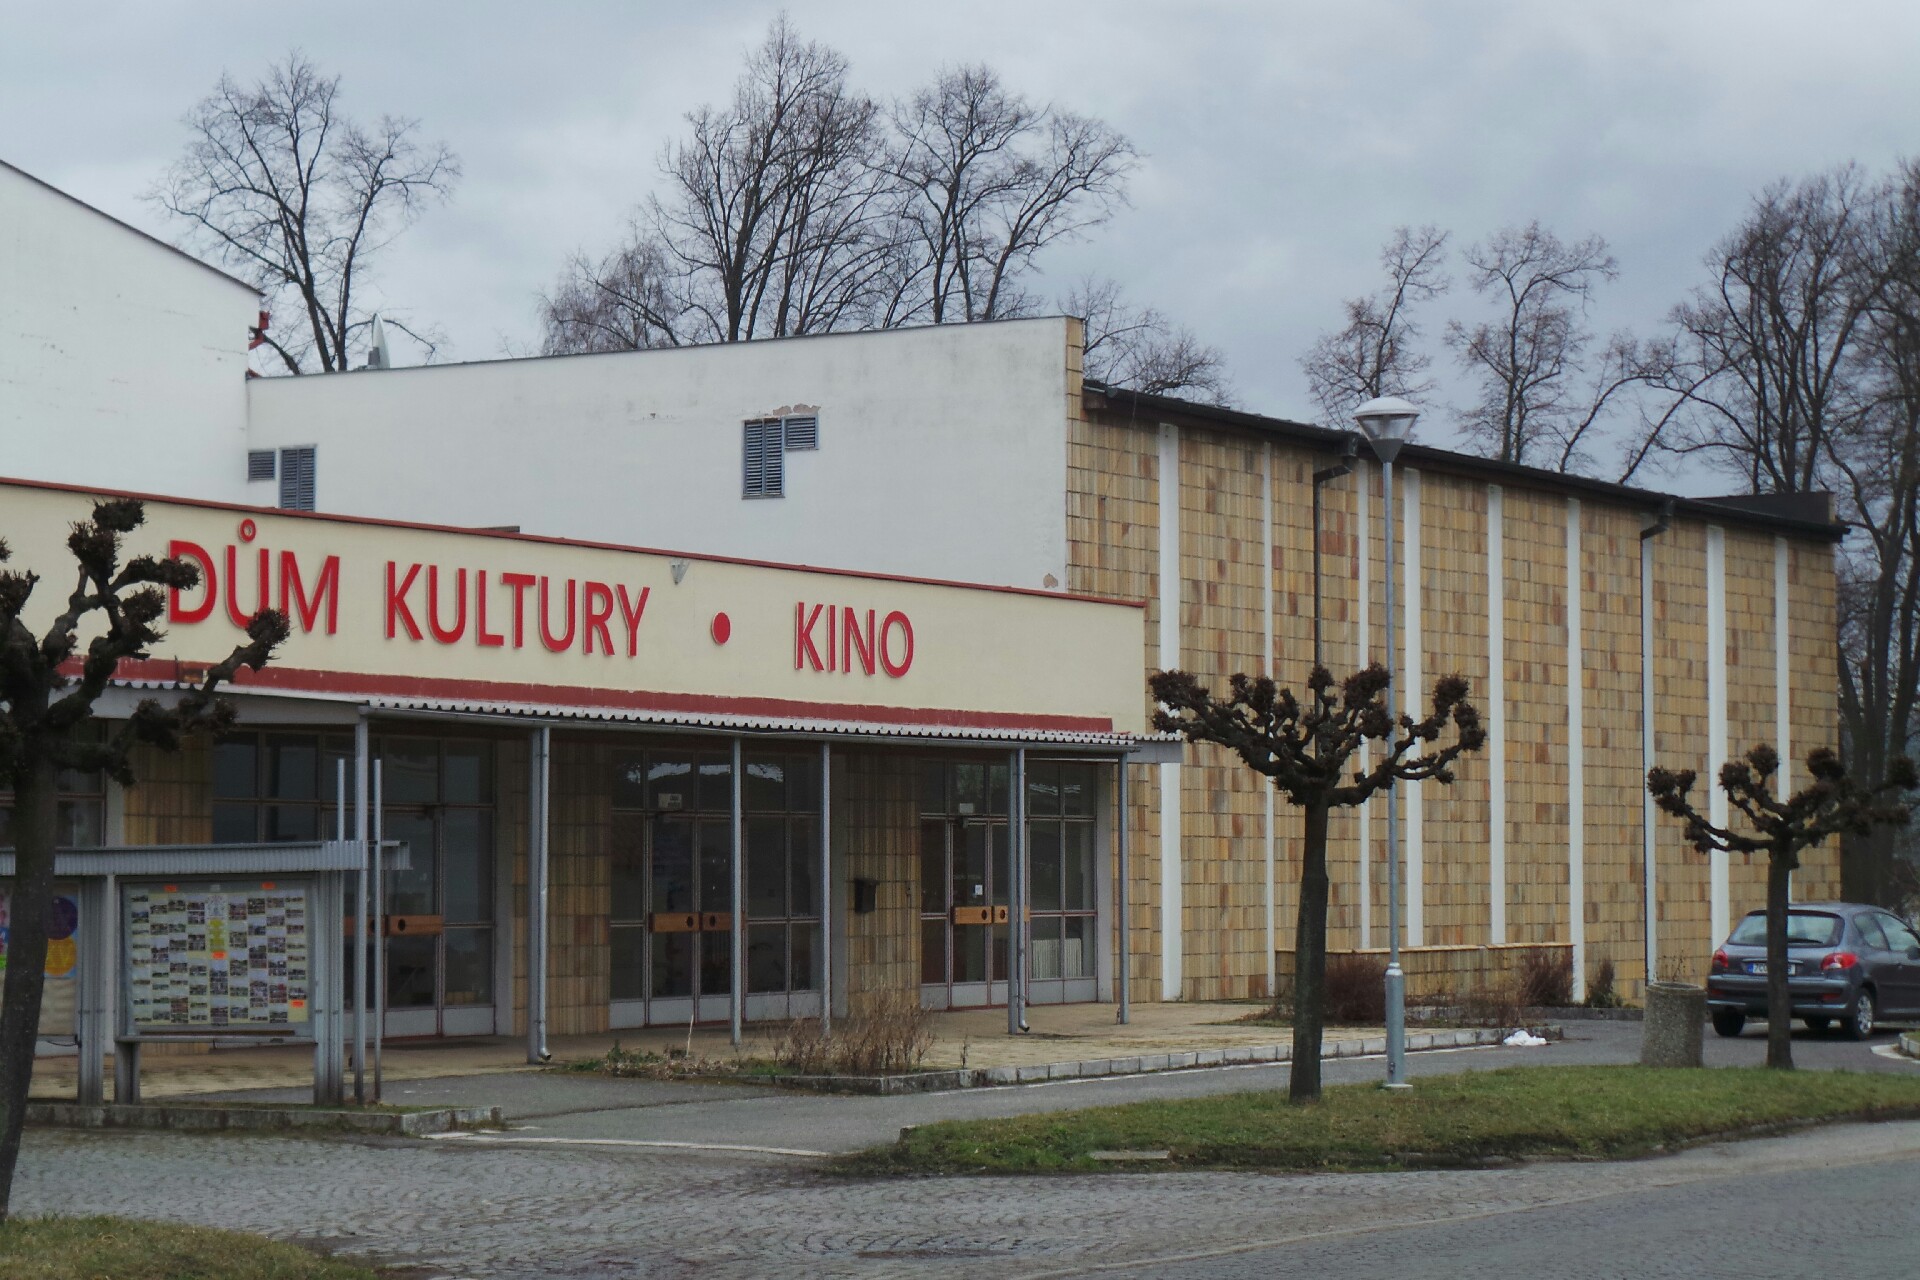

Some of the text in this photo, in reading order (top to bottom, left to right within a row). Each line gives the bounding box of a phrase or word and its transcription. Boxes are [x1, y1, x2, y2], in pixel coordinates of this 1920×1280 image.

[168, 518, 915, 678] DŮM KULTURY KINO
